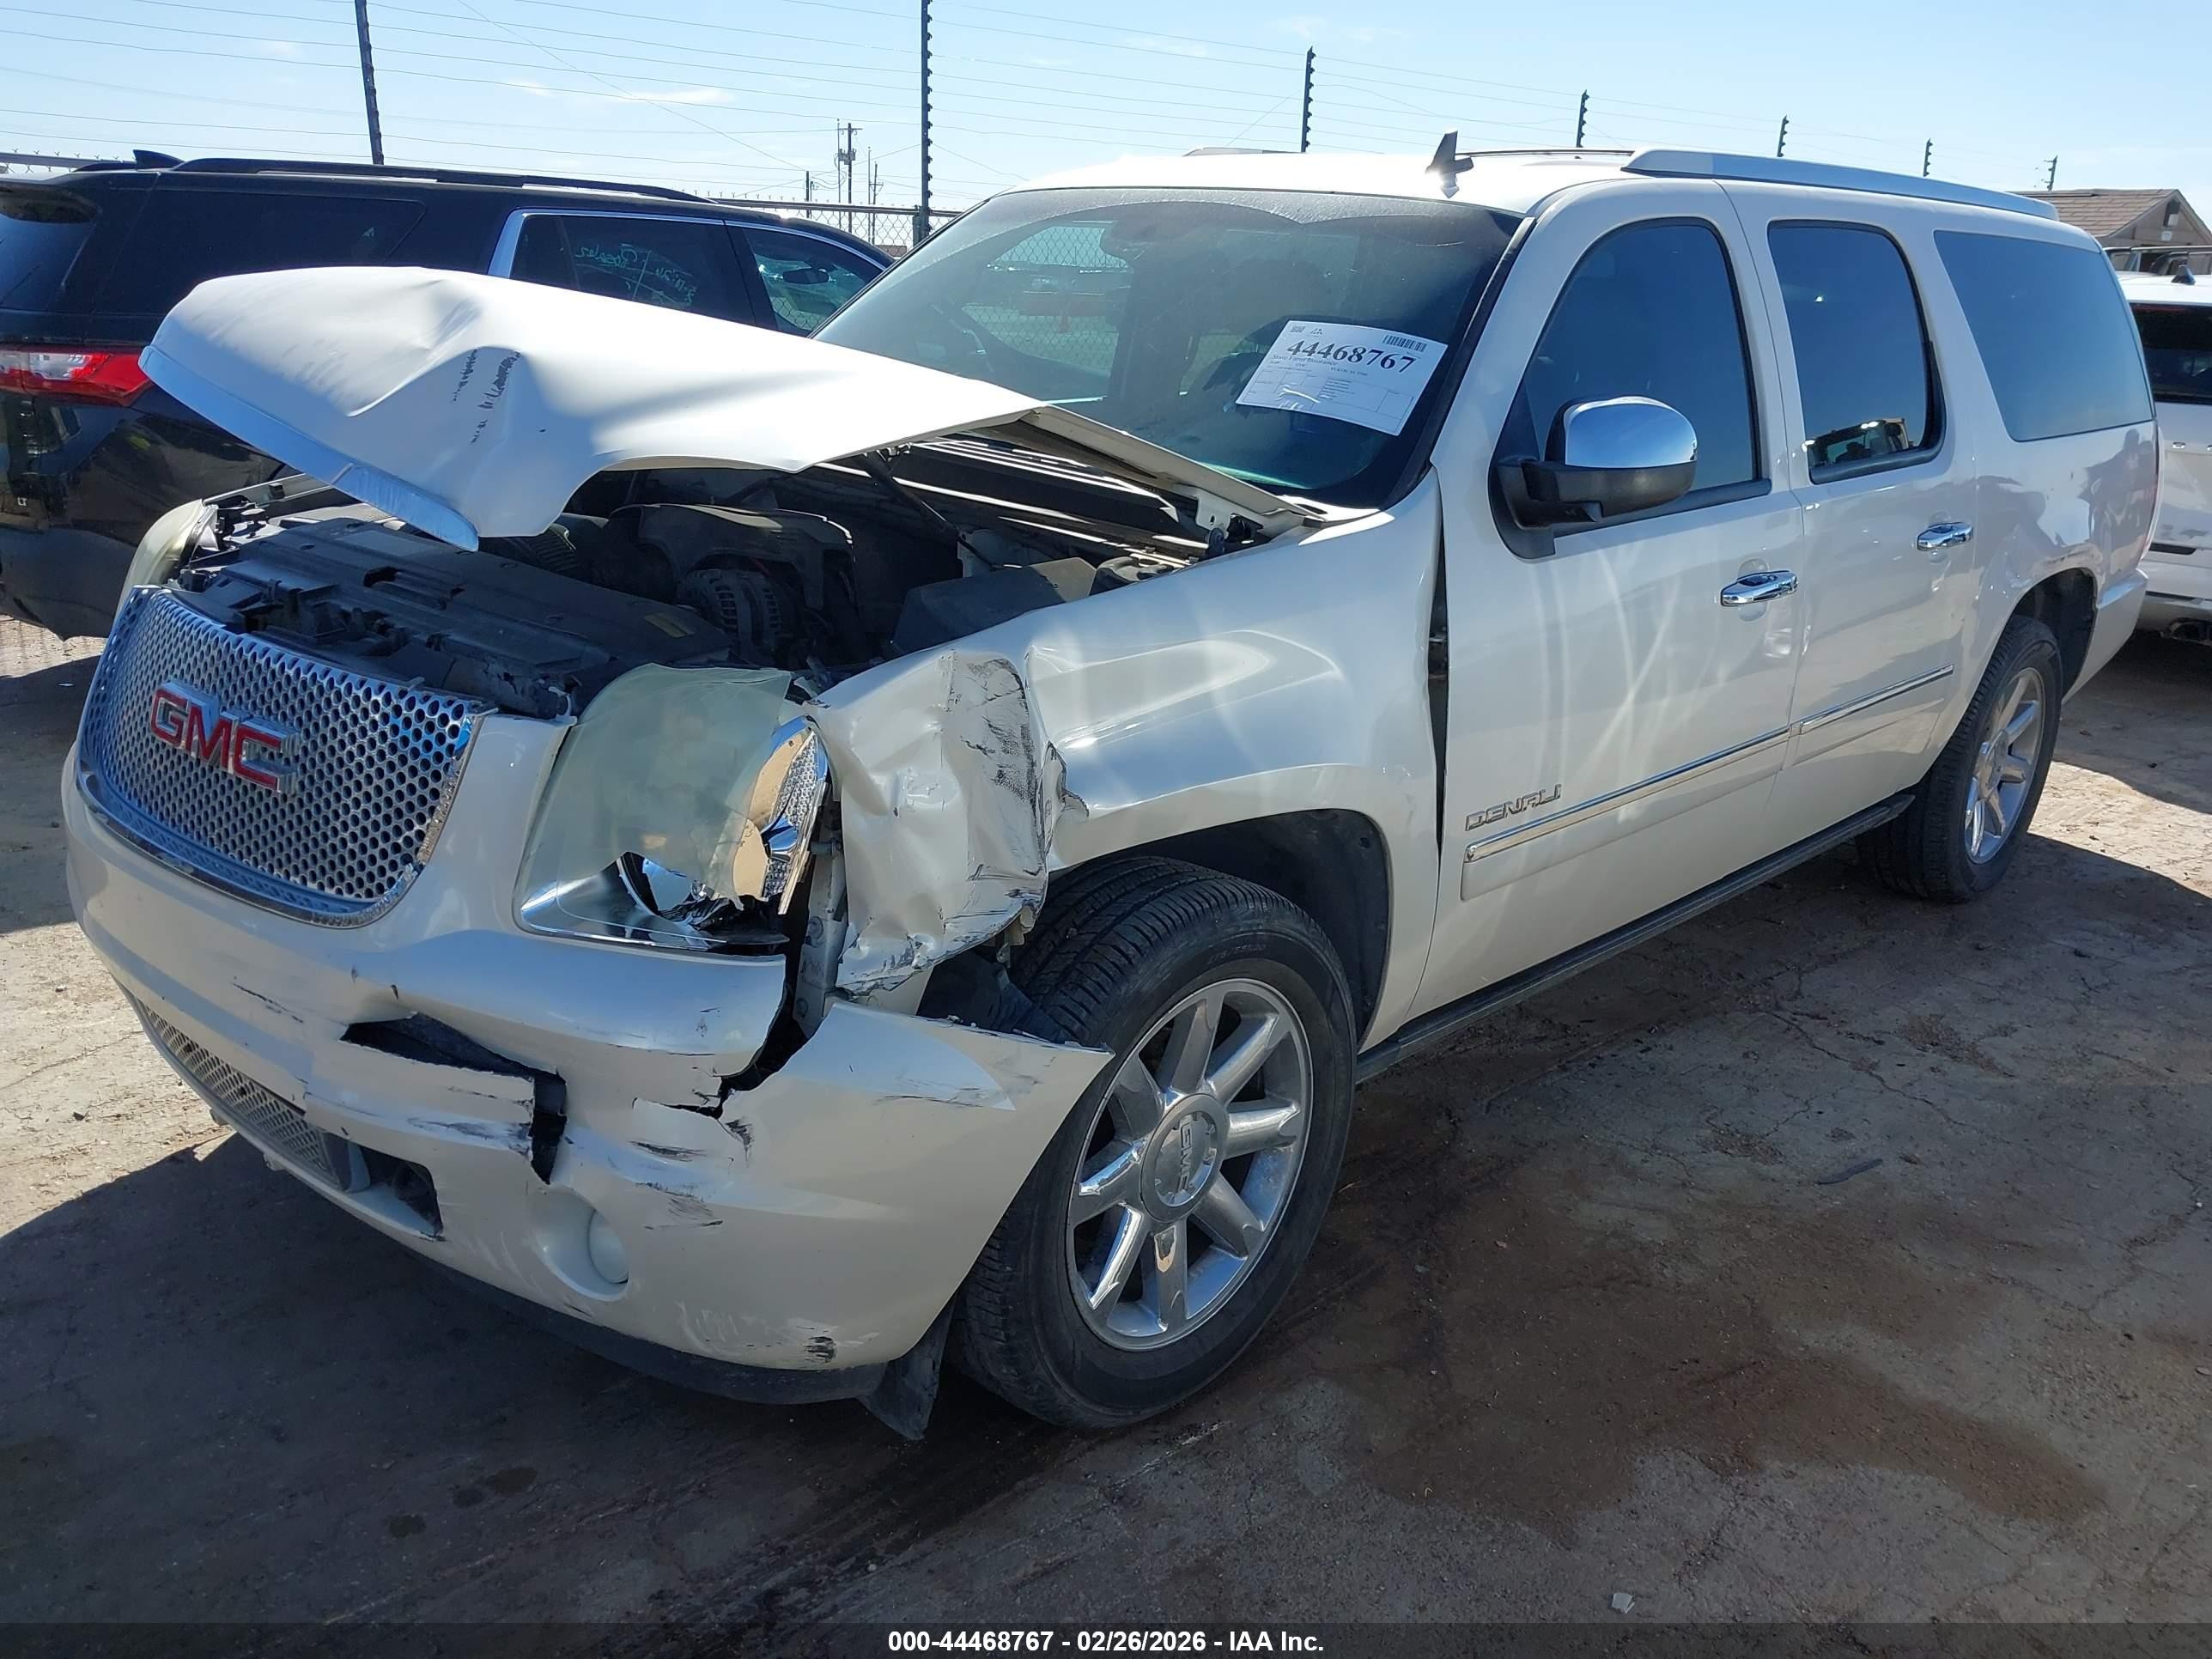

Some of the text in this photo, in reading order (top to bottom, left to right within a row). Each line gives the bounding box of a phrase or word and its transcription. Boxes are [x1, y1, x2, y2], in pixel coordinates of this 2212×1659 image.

[1287, 340, 1417, 373] 44468767
[150, 684, 293, 793] GMC
[1464, 783, 1562, 831] DENALI
[1176, 1120, 1193, 1192] GMC
